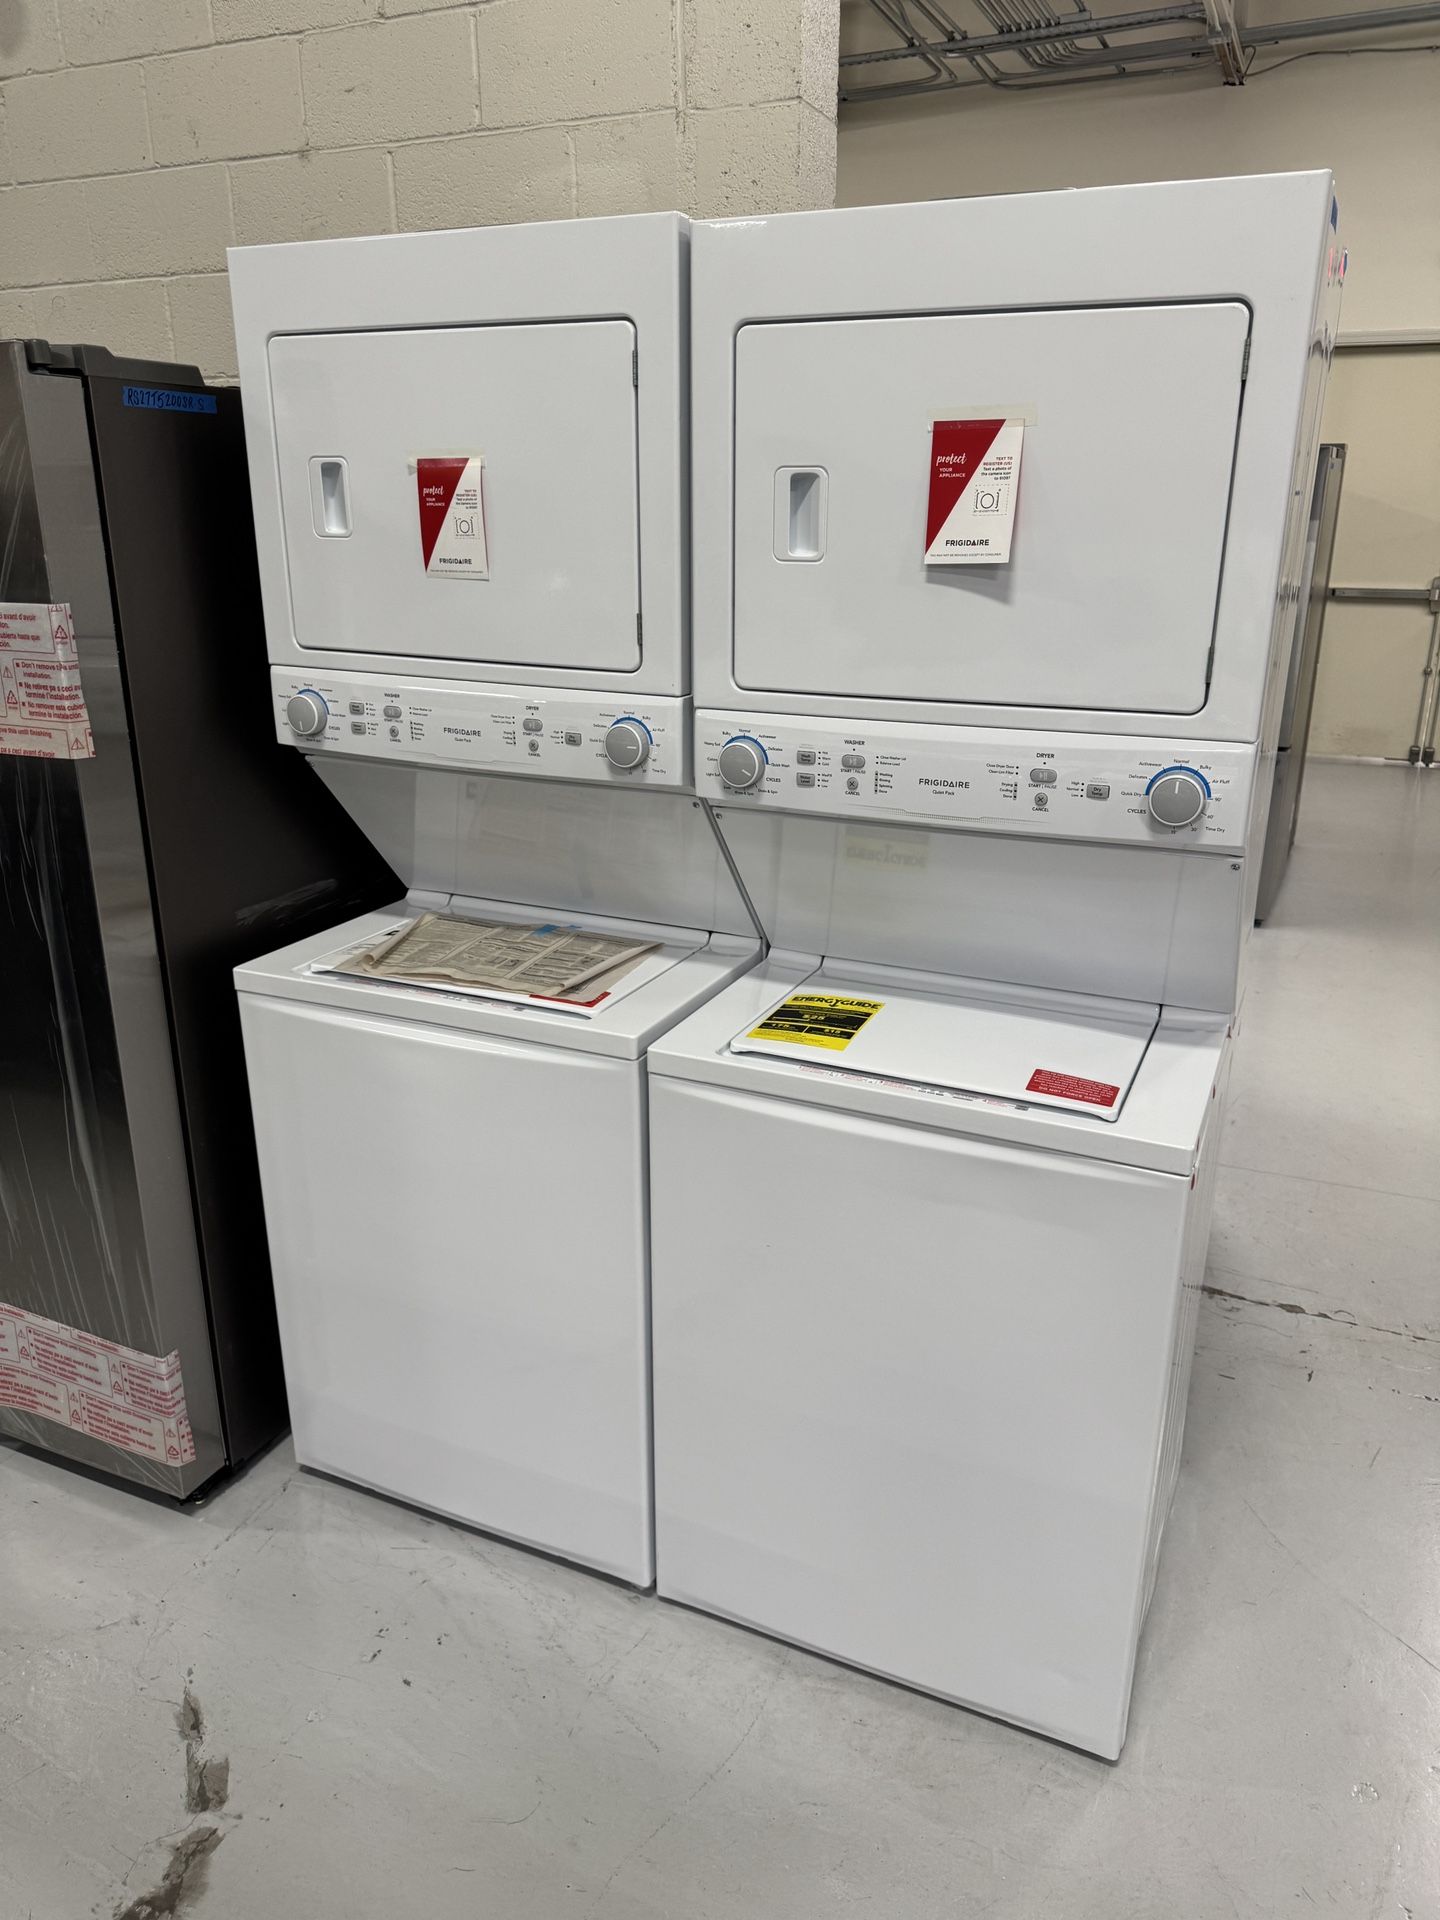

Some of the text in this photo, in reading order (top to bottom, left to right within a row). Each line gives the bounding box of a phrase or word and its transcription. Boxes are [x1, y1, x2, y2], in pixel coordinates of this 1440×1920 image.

[936, 453, 967, 466] protect
[423, 485, 444, 496] protect
[443, 727, 481, 736] FRIGIDAIRE
[919, 778, 970, 788] FRIGIDAIRE
[792, 996, 881, 1009] ENERGYGUIDE
